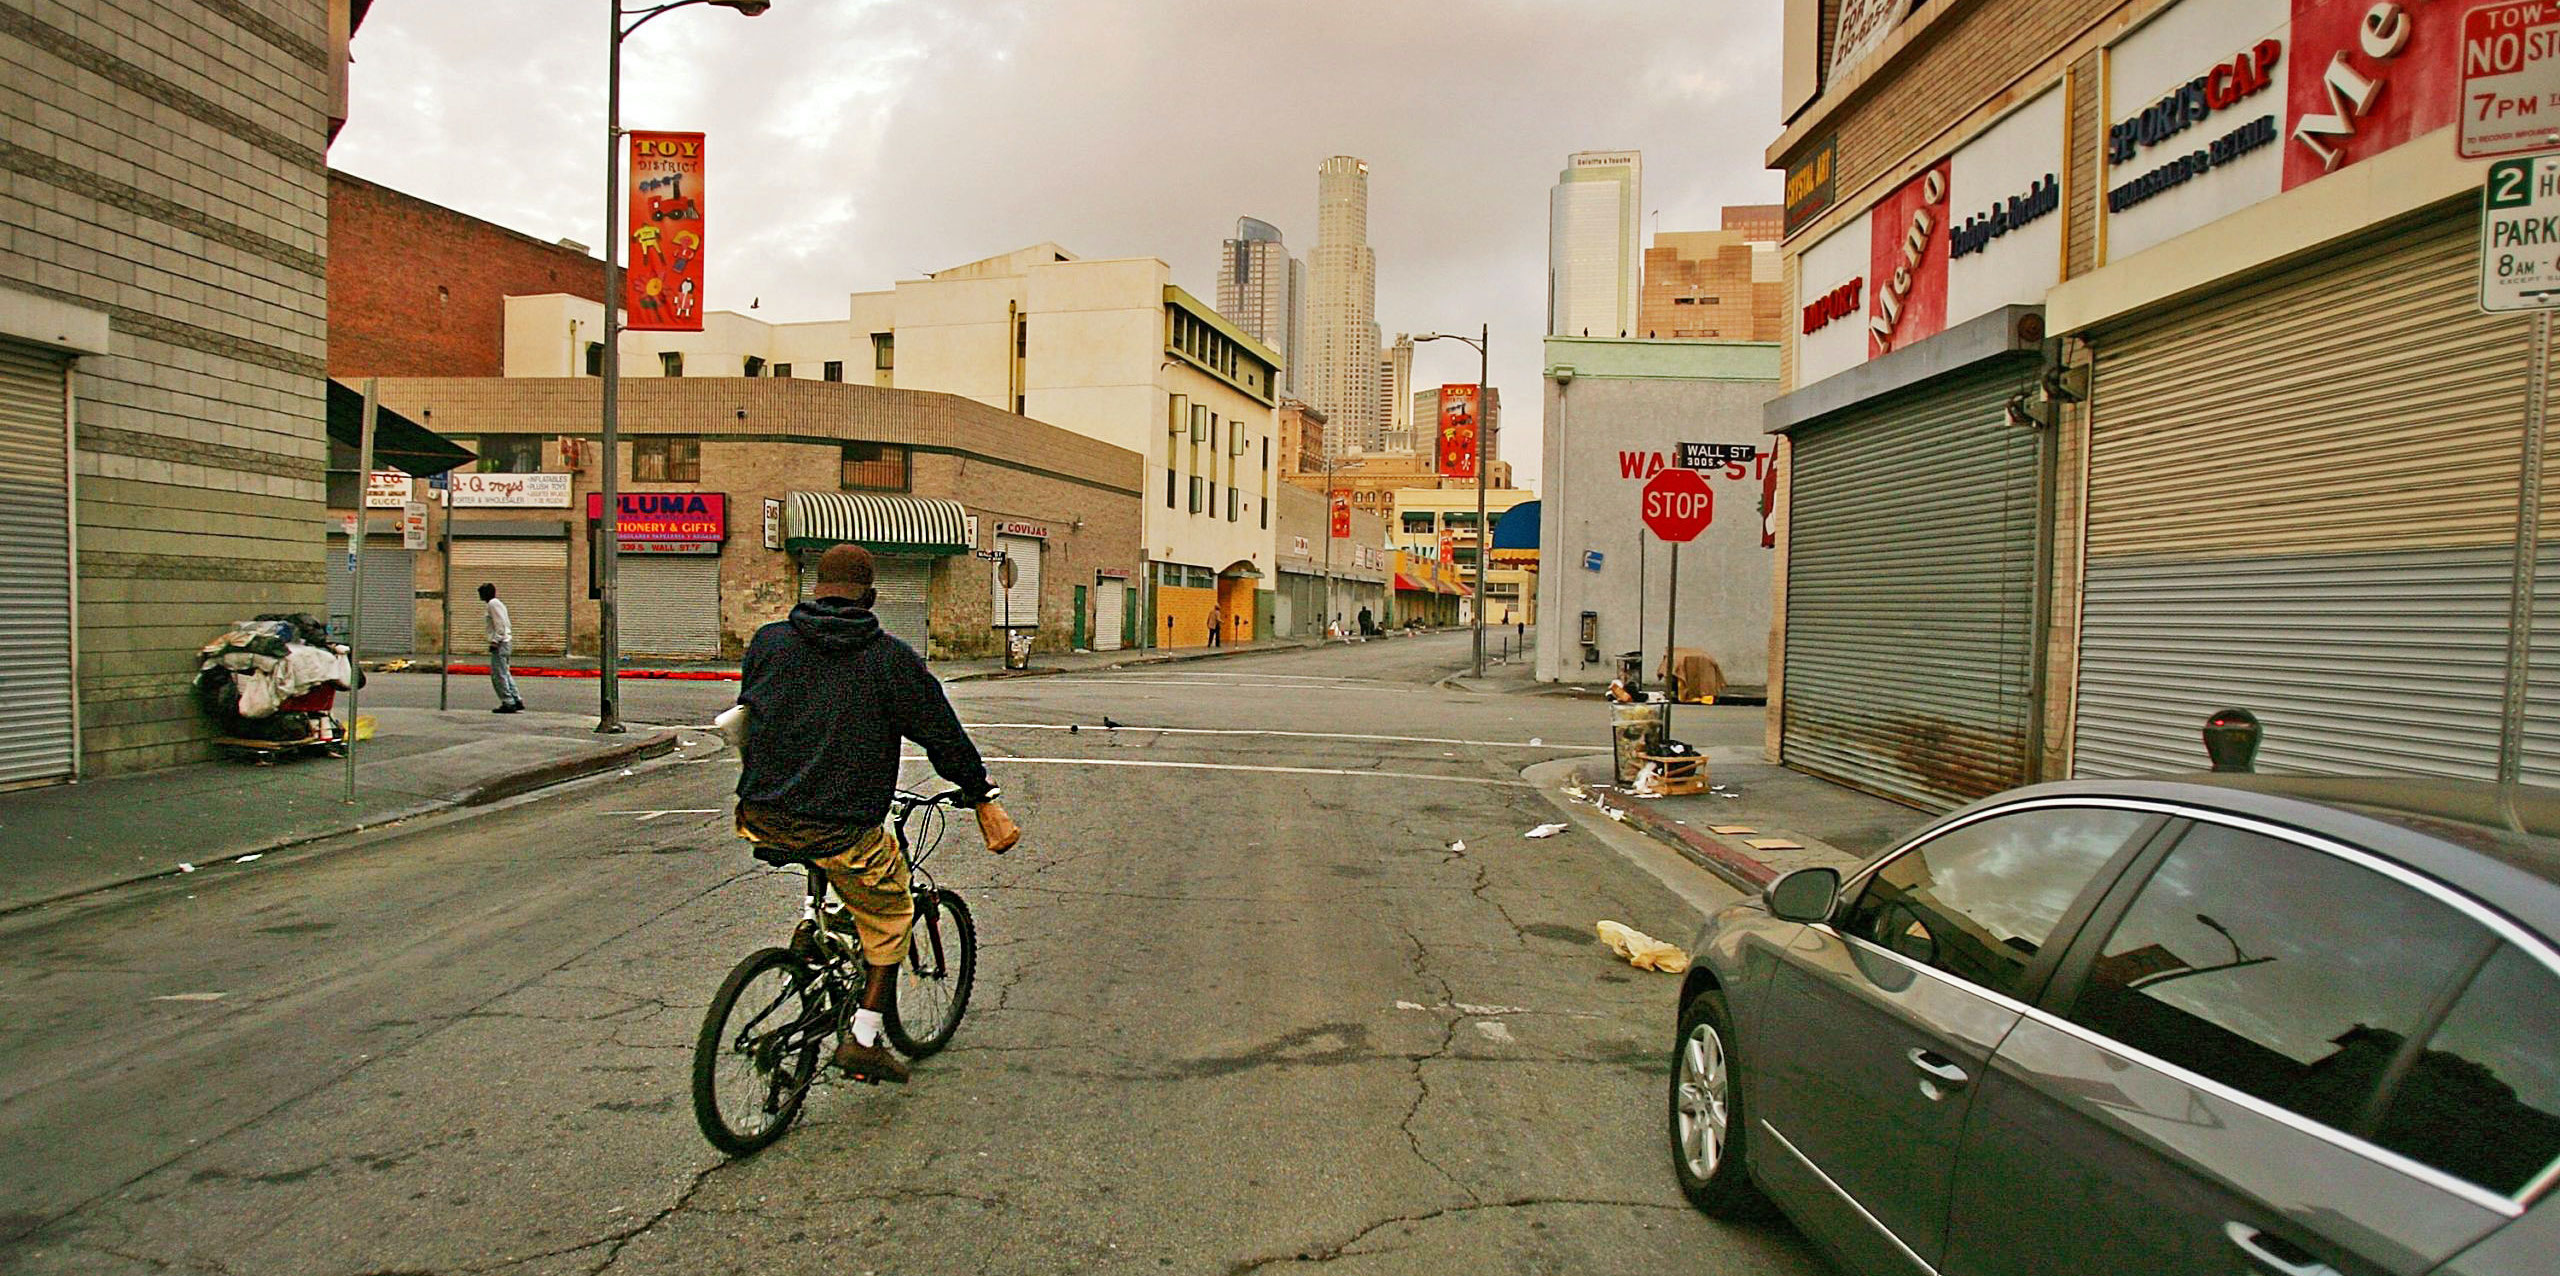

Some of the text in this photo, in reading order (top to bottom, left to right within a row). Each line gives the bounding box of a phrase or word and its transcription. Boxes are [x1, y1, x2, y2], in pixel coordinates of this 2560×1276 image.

[2468, 29, 2560, 75] NO ST
[2291, 2, 2411, 171] Me
[634, 139, 699, 157] TOY
[2209, 114, 2278, 167] RETAIL
[638, 160, 698, 173] DISTRICT
[2496, 168, 2560, 202] 2 H
[2493, 215, 2560, 248] PARK
[1868, 169, 1946, 356] Memo
[1687, 445, 1725, 458] WALL
[371, 498, 401, 506] GUCCI
[617, 496, 708, 514] LUMA
[1647, 491, 1708, 519] STOP
[617, 522, 717, 532] TIONERY & GIFTS
[1007, 523, 1048, 537] COVIJAS
[651, 543, 674, 552] WALL
